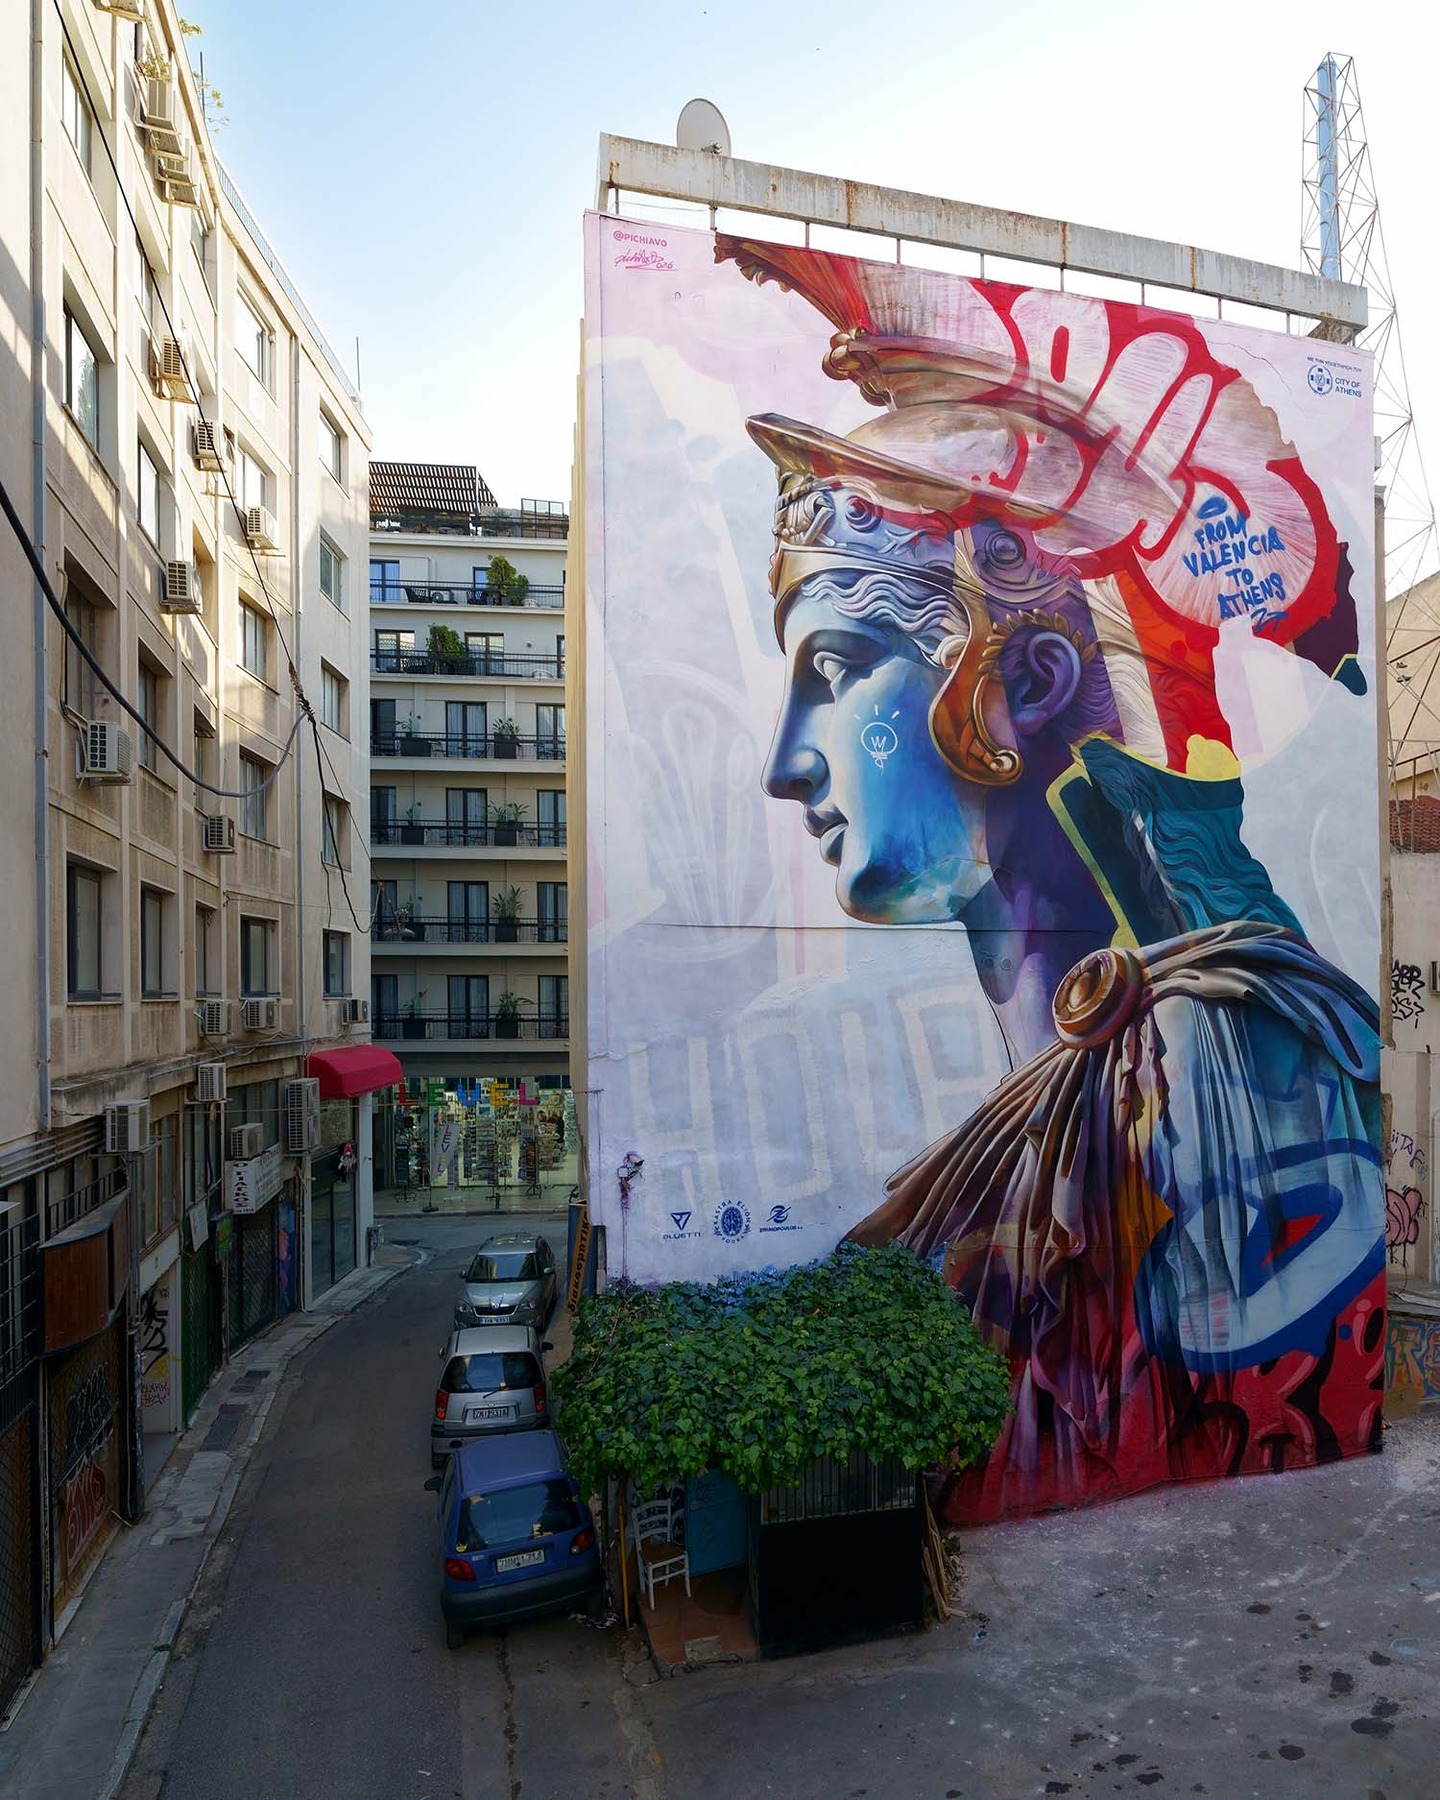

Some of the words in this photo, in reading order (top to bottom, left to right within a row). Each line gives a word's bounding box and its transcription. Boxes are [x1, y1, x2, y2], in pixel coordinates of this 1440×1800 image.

[613, 231, 668, 247] @PICHIAVO
[1335, 377, 1351, 386] CITY
[1335, 386, 1361, 397] ATHENS
[1194, 510, 1249, 551] FROM
[1182, 525, 1286, 578] VALENCIA
[1225, 567, 1254, 588] TO
[1217, 571, 1287, 621] ATHENS
[437, 1124, 452, 1173] LEVEL
[713, 1199, 733, 1225] KASTRA
[736, 1200, 751, 1223] ELION
